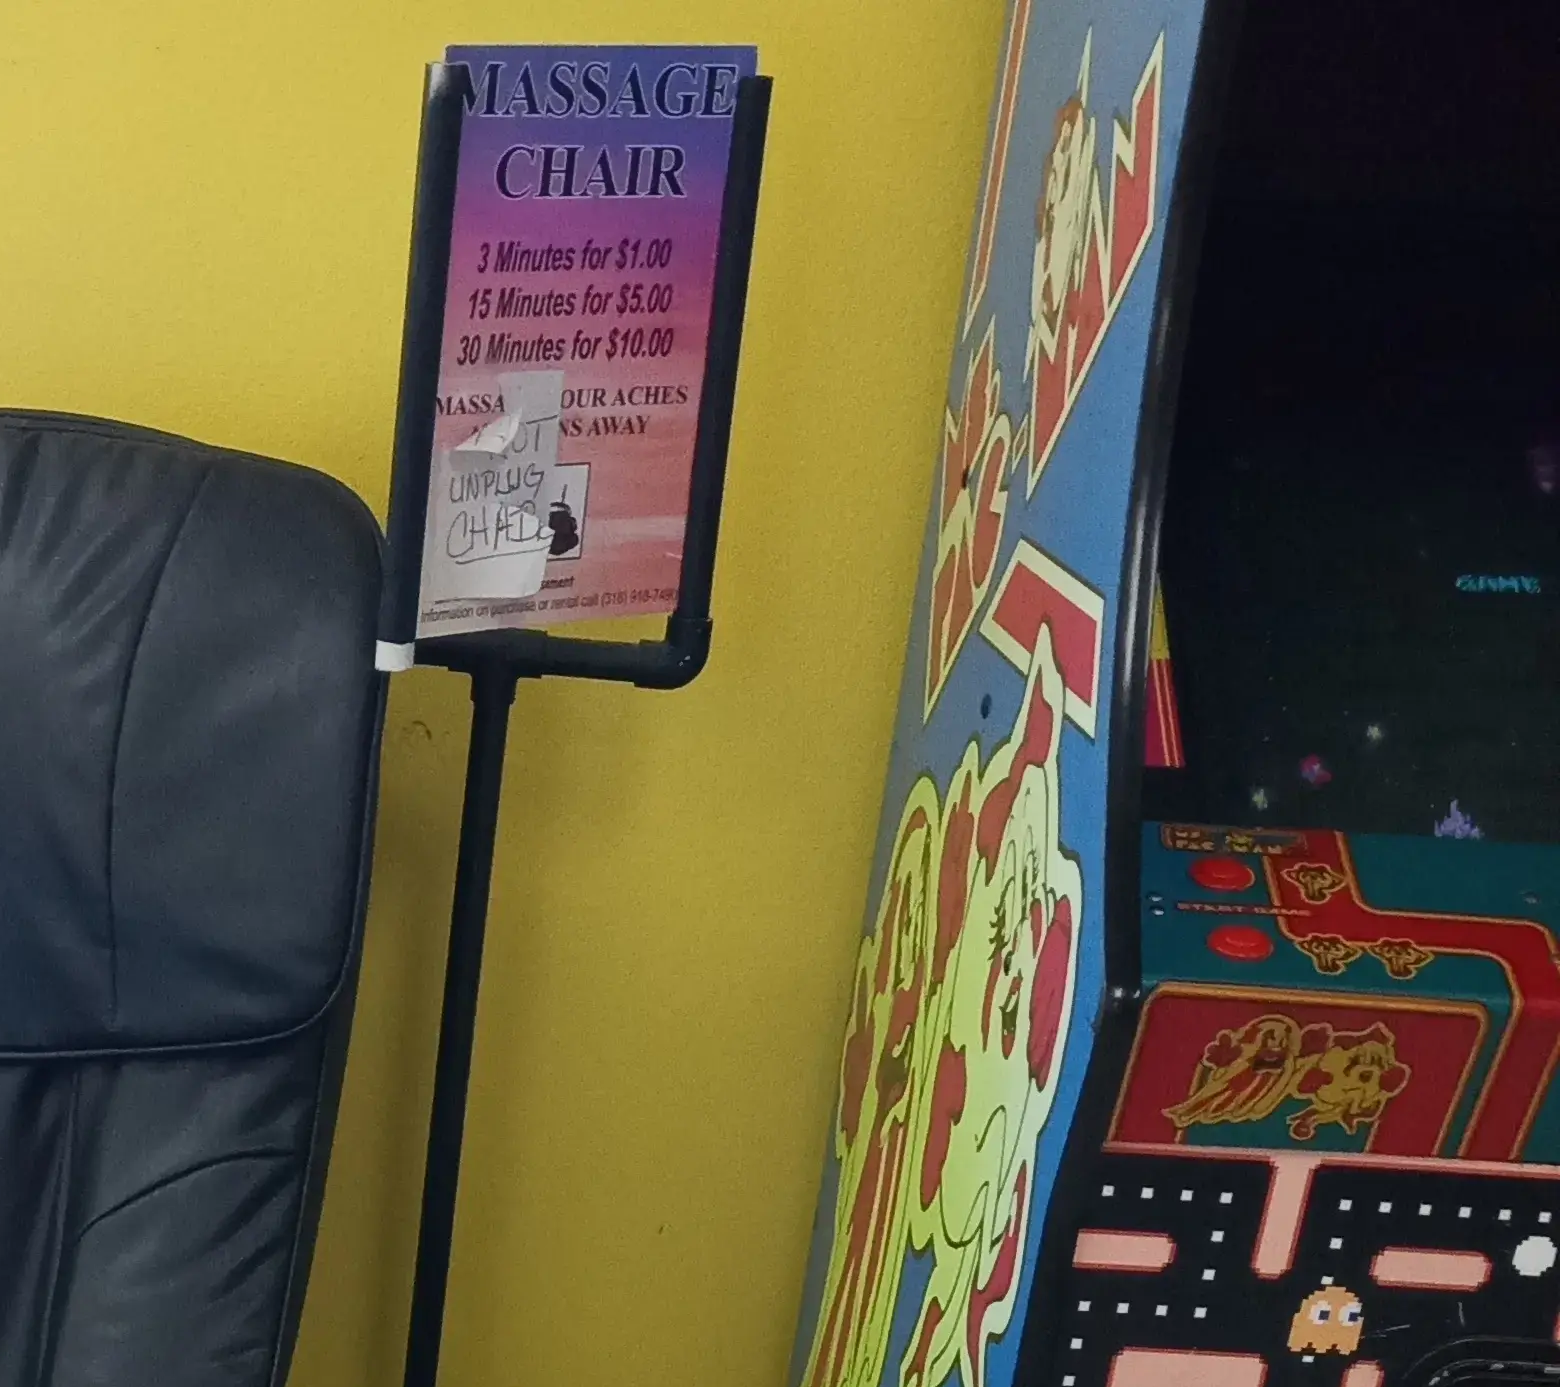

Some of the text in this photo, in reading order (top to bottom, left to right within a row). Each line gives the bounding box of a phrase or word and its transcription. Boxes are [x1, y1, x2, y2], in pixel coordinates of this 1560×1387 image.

[459, 60, 738, 119] MASSAGE
[494, 143, 688, 201] CHAIR
[476, 237, 674, 274] 3 Minutes for $1.00
[468, 282, 675, 320] 15 Minutes for $5.00
[456, 326, 675, 366] 30 Minutes for $10.00
[436, 384, 689, 416] MASSA OUR ACHES
[586, 414, 651, 437] AWAY
[449, 462, 546, 503] UNPLUG
